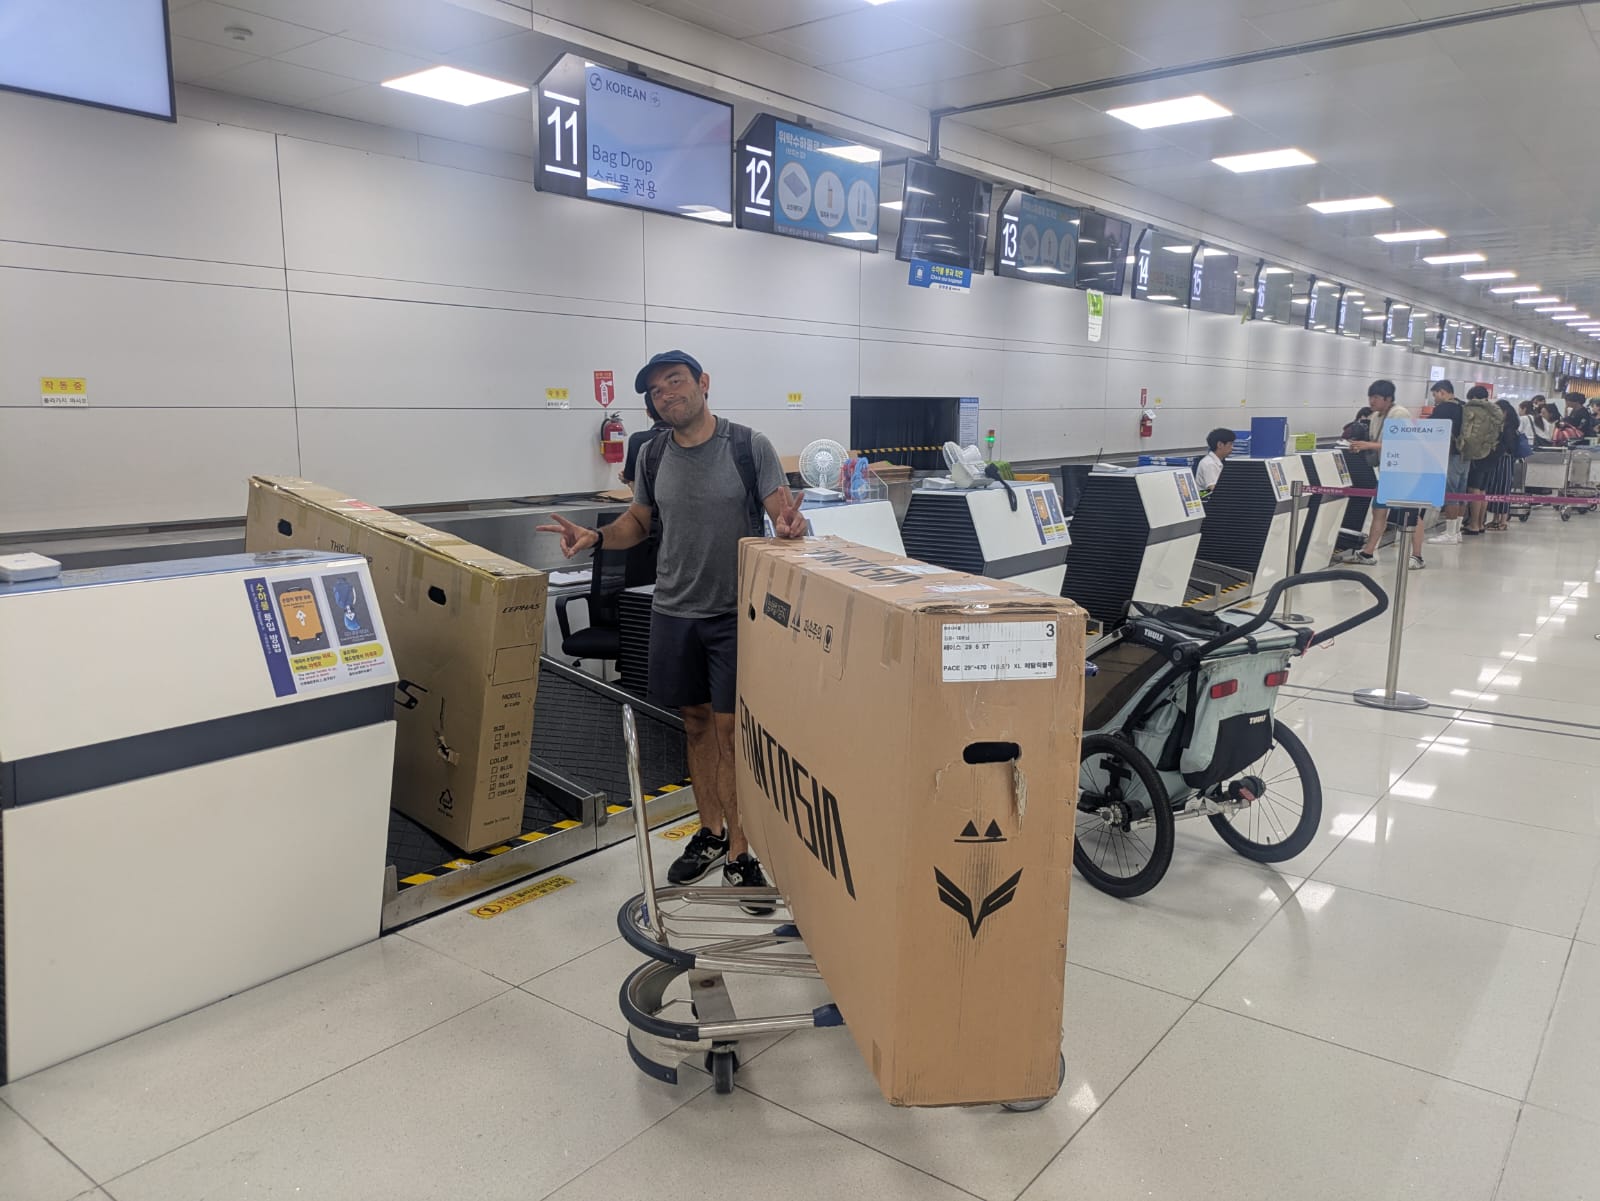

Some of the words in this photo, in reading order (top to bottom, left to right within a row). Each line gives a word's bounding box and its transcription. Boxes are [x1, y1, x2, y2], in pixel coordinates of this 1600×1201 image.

[606, 80, 647, 101] KOREAN
[547, 106, 578, 165] 11
[592, 144, 617, 168] Bag
[621, 151, 653, 175] Drop
[634, 178, 657, 199] 전용
[746, 158, 771, 206] 12
[1002, 222, 1017, 258] 13
[1139, 256, 1149, 284] 14
[1193, 269, 1202, 295] 15
[1400, 426, 1433, 434] KOREAN
[1045, 623, 1055, 637] 3
[1144, 628, 1164, 642] THULE
[739, 693, 857, 901] FANTASIA
